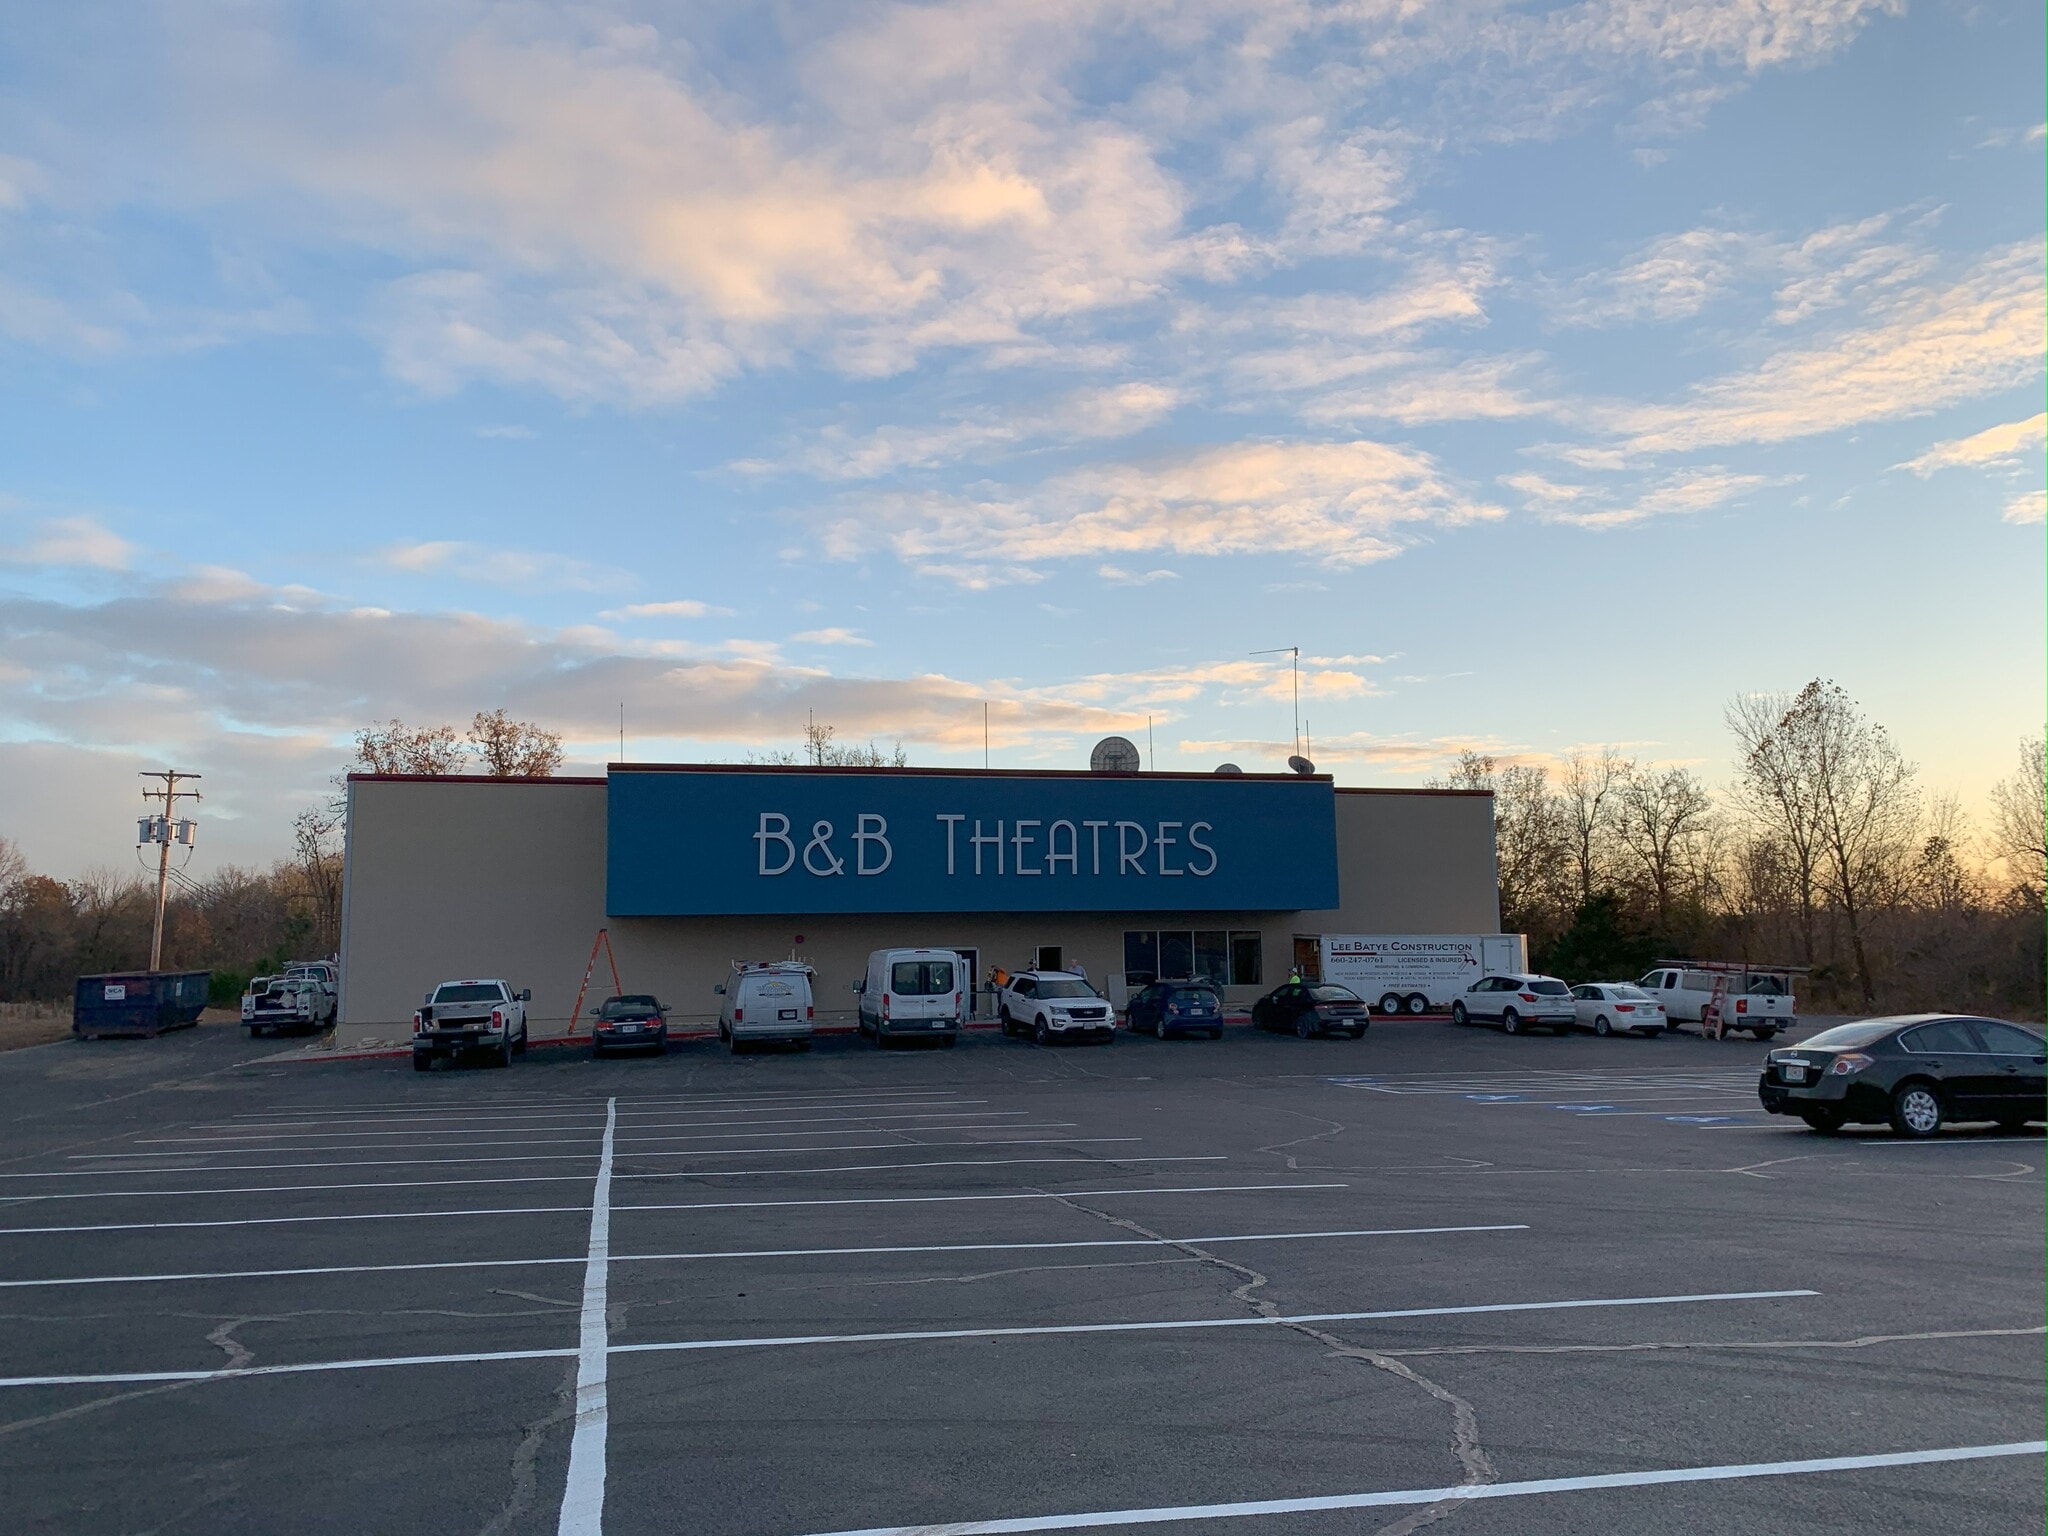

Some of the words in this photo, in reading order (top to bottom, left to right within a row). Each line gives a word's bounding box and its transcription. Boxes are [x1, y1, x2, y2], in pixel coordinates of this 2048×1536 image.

[753, 812, 893, 877] B&B
[936, 813, 1218, 877] THEATRES
[1331, 941, 1351, 951] LEE
[1355, 941, 1388, 951] BATYE
[1391, 941, 1472, 951] CONSTRUCTION
